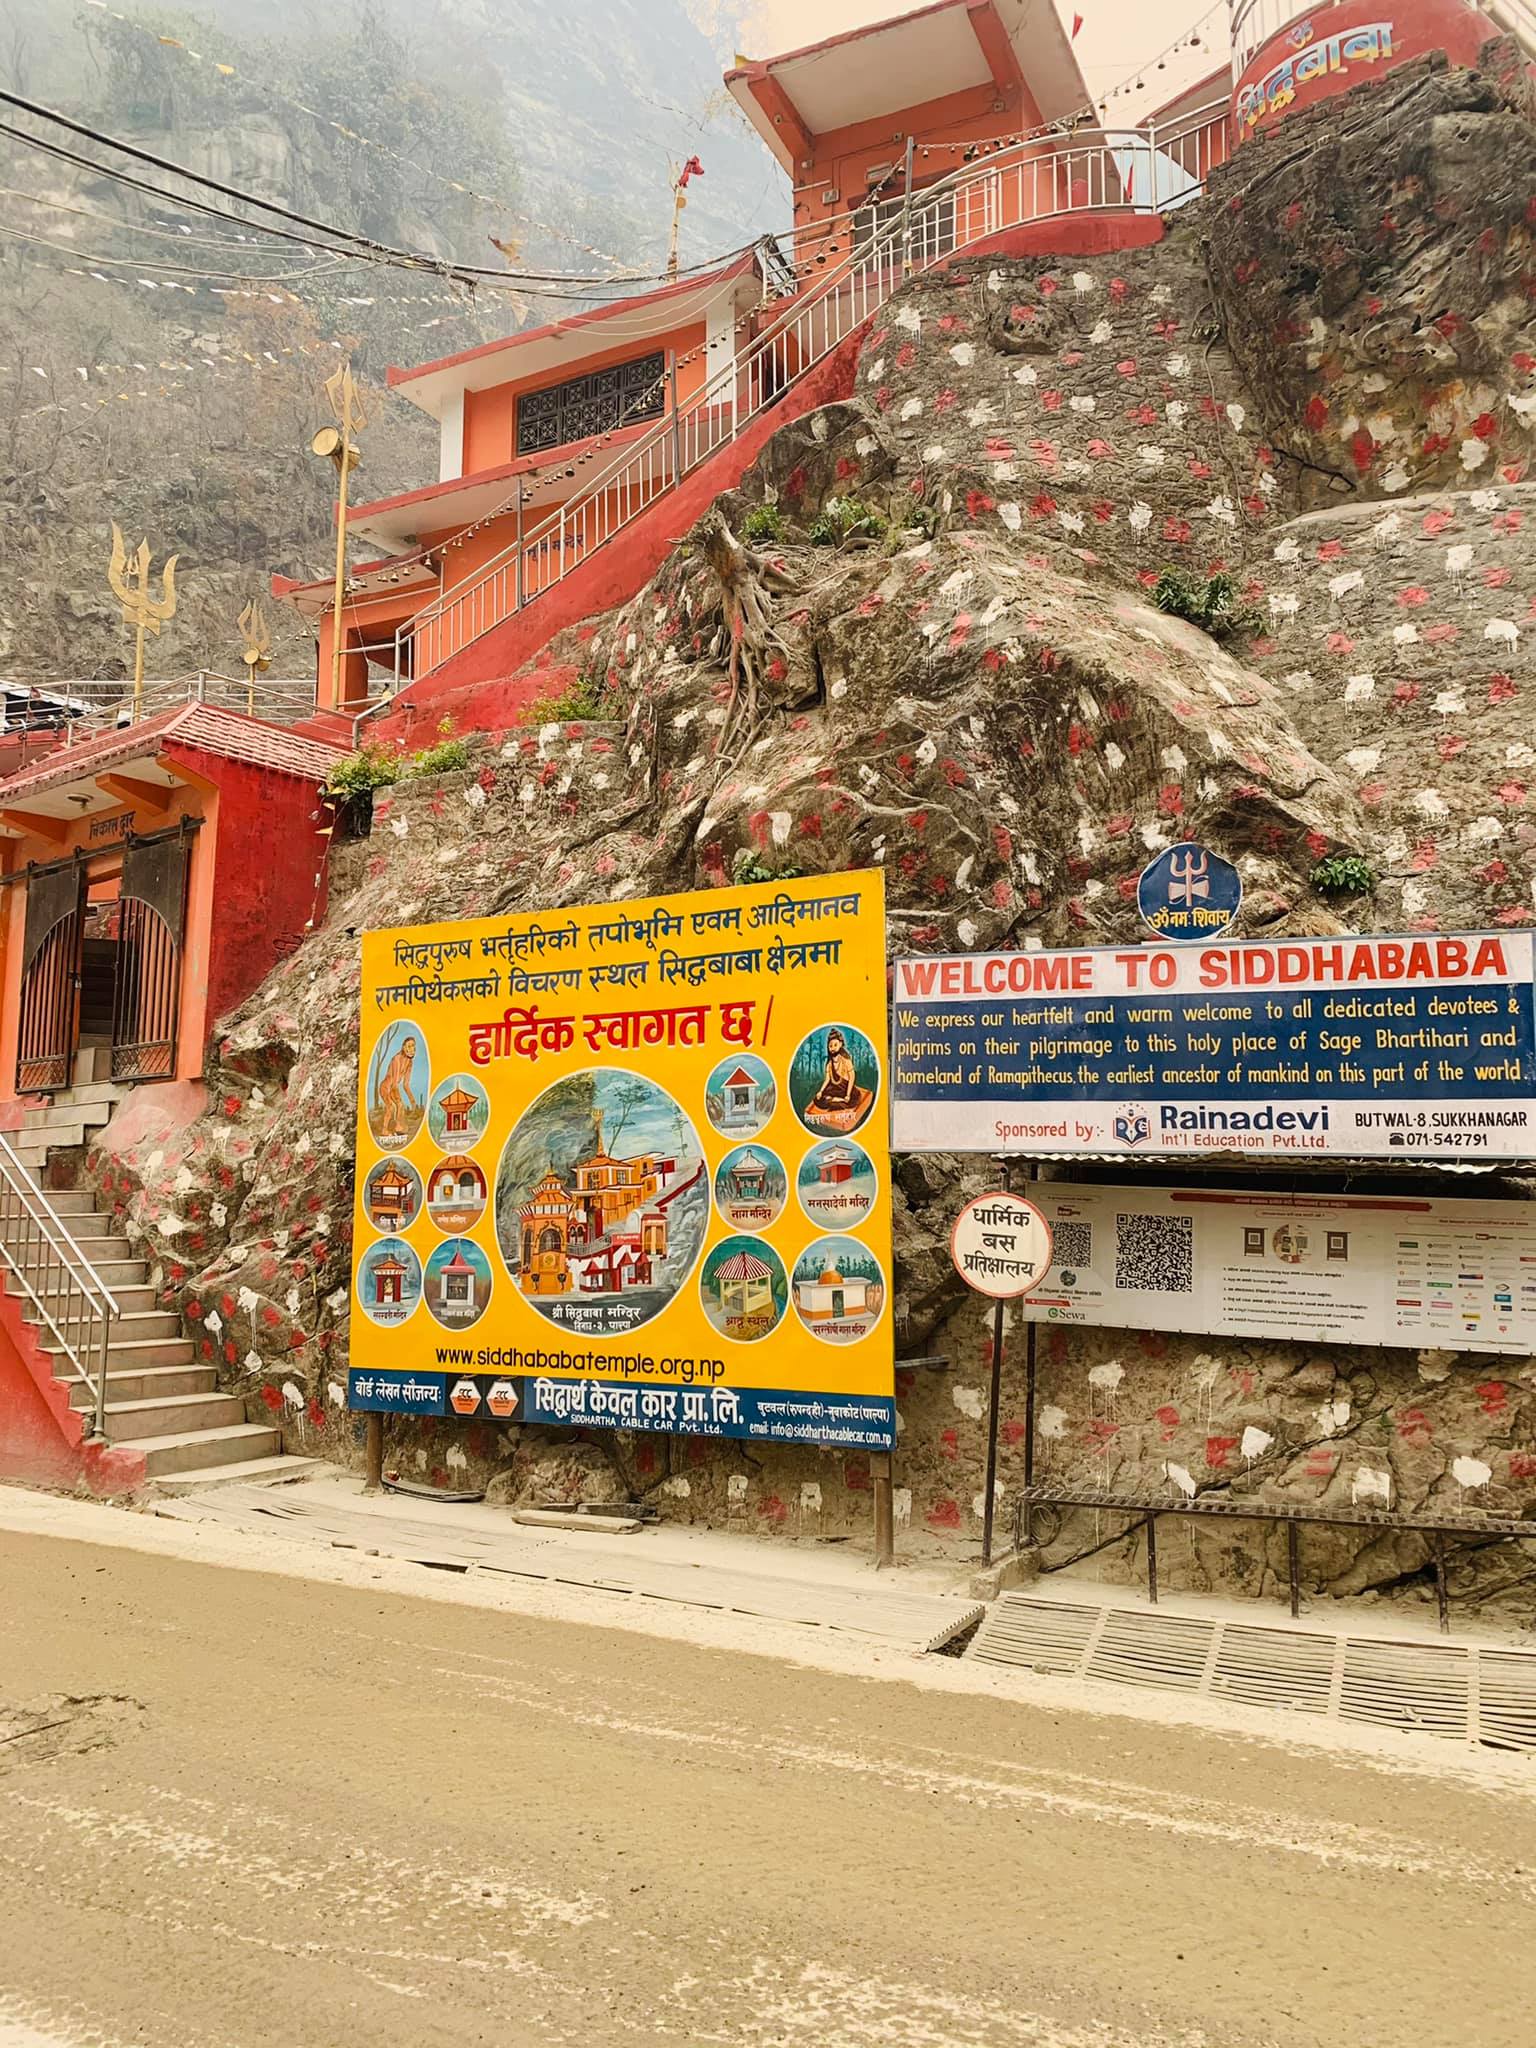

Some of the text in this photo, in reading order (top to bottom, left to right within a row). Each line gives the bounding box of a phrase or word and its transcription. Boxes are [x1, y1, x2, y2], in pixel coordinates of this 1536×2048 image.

[588, 908, 684, 951] तपोभूमि
[691, 907, 741, 937] एवम्
[747, 893, 861, 928] आदिमानव
[1192, 906, 1231, 928] शिवाय
[508, 966, 582, 996] विचरण
[589, 961, 649, 992] स्थल
[766, 935, 842, 971] क्षेत्रमा
[901, 939, 1508, 996] WELCOME TO SIDDHABABA
[898, 995, 1520, 1031] We express our heartfelt and warm welcome to all dedicated devotees &
[469, 1005, 575, 1066] हार्दिक
[583, 1004, 711, 1052] स्वागत
[898, 1025, 1516, 1061] pilgrims on their pilgrimage to this holy place of Sage Bhartihari and
[897, 1066, 962, 1085] homeland
[968, 1066, 982, 1085] of
[1106, 1064, 1154, 1084] earliest
[1162, 1064, 1220, 1083] ancestor
[1227, 1061, 1242, 1082] of
[1248, 1061, 1309, 1083] mankind
[1315, 1067, 1332, 1082] on
[1338, 1061, 1365, 1082] this
[1373, 1063, 1404, 1087] part
[1414, 1060, 1430, 1081] of
[1439, 1060, 1464, 1080] the
[1161, 1105, 1329, 1131] Rainadevi
[995, 1121, 1067, 1142] Sponsored
[1194, 1133, 1264, 1148] Education
[1407, 1132, 1488, 1146] 071-542791
[749, 1206, 771, 1220] मन्दिर
[972, 1203, 1031, 1227] धार्मिक
[982, 1232, 1017, 1253] बस
[963, 1250, 1035, 1279] प्रतिक्षालय
[607, 1304, 641, 1321] मन्दिर
[436, 1346, 725, 1383] www.siddhababatemple.org.np
[641, 1389, 677, 1421] कार
[570, 1413, 723, 1435] SIDDHARTHA CABLE CAR Pvt. Ltd.
